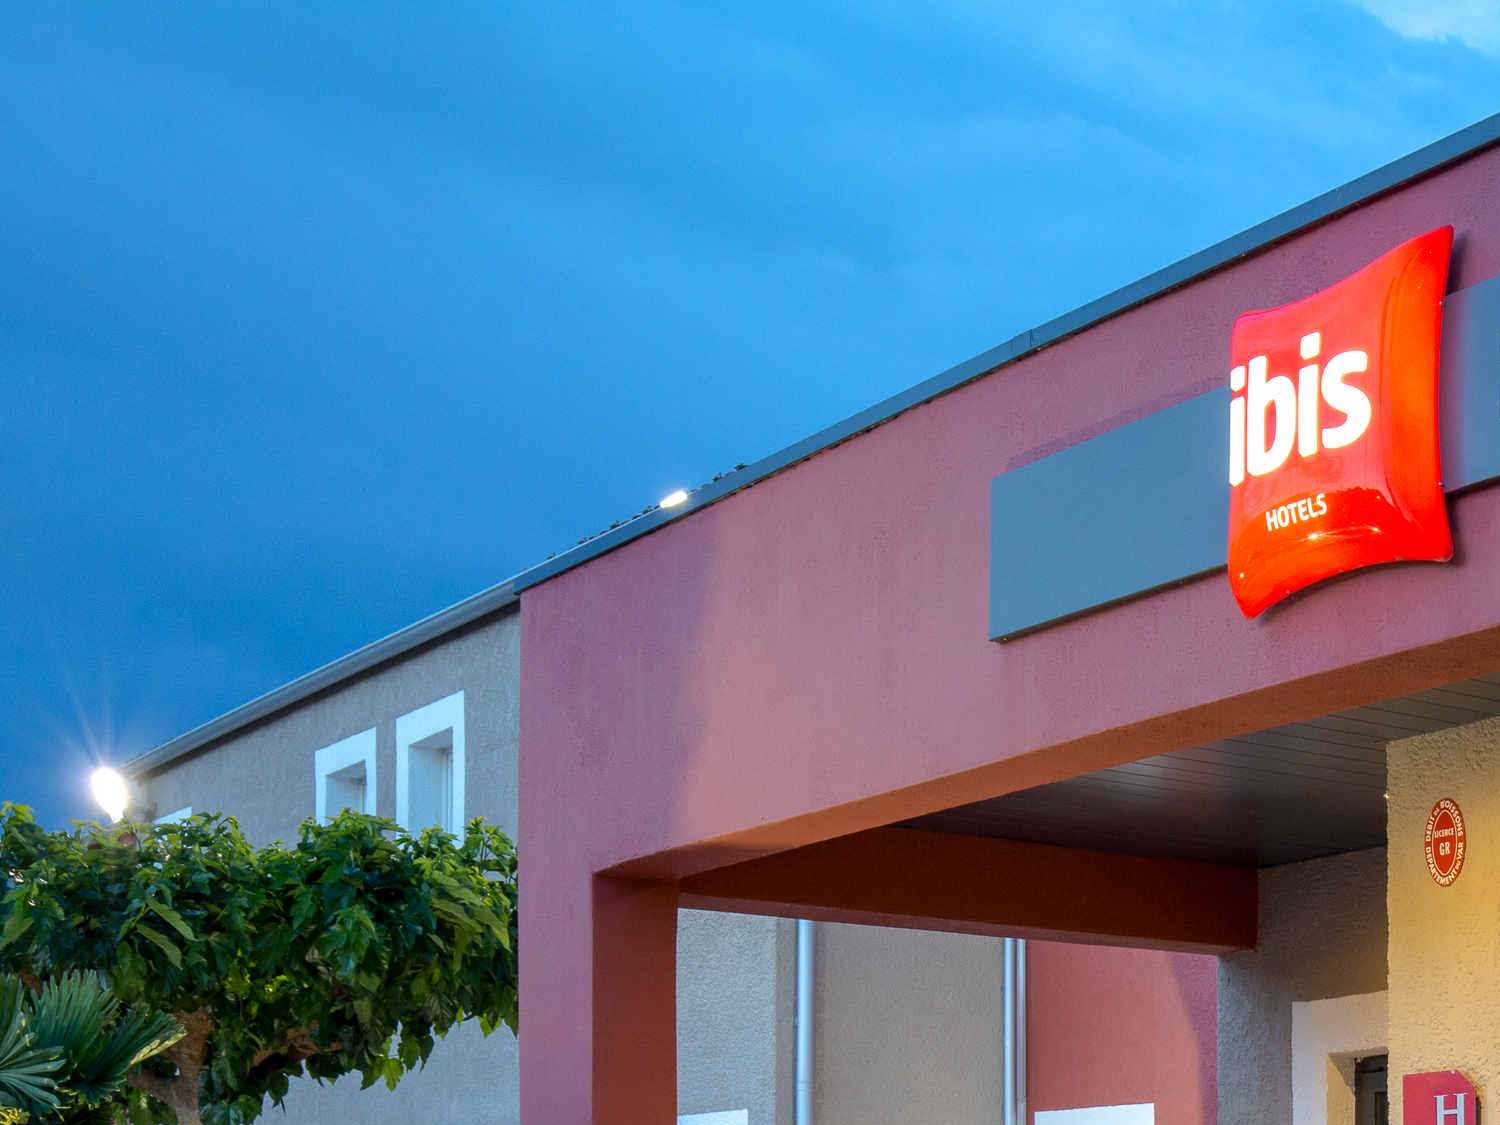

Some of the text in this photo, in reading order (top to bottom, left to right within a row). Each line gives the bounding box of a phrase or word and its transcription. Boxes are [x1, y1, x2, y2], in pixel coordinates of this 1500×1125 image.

[1229, 331, 1372, 487] ibis
[1266, 493, 1328, 532] HOTELS
[1434, 827, 1454, 838] LICENCE
[1440, 800, 1464, 837] BOISSONS
